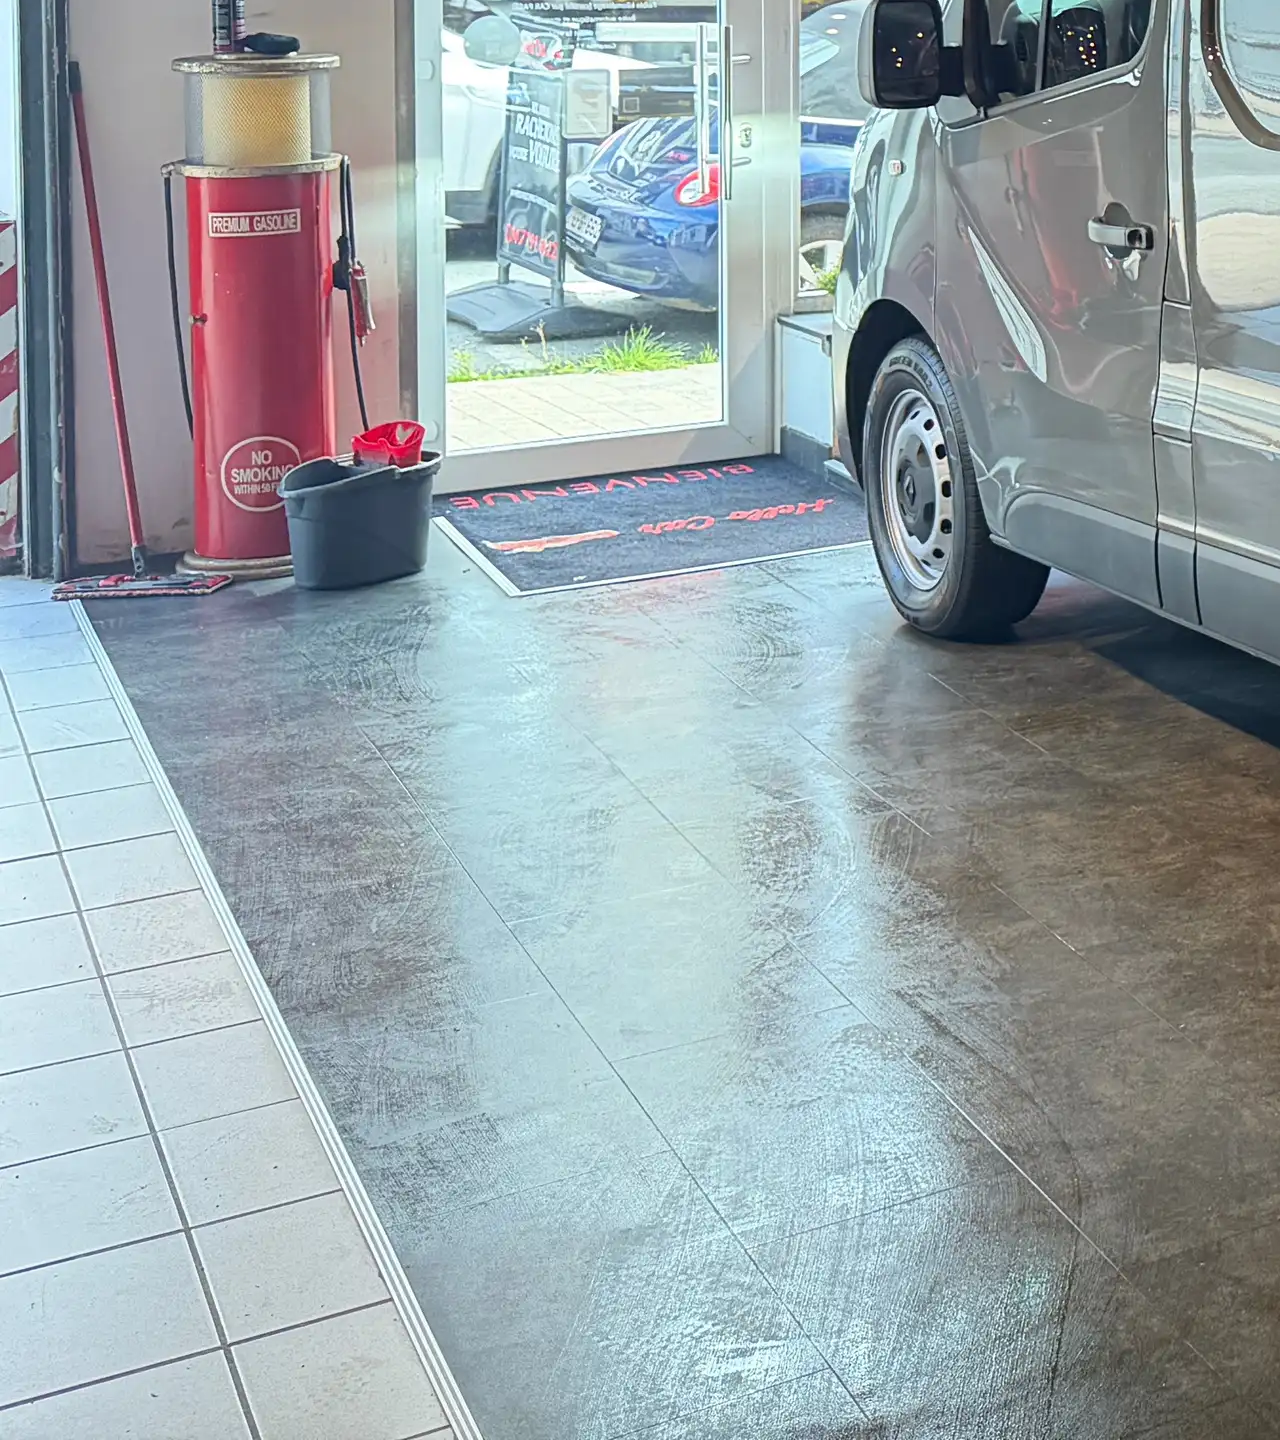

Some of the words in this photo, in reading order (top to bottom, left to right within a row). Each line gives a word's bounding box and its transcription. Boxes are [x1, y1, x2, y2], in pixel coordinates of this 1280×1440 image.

[212, 217, 250, 234] PREMIUM
[253, 212, 297, 231] GASOLINE
[251, 450, 272, 465] NO
[449, 463, 755, 510] BIENVENUE
